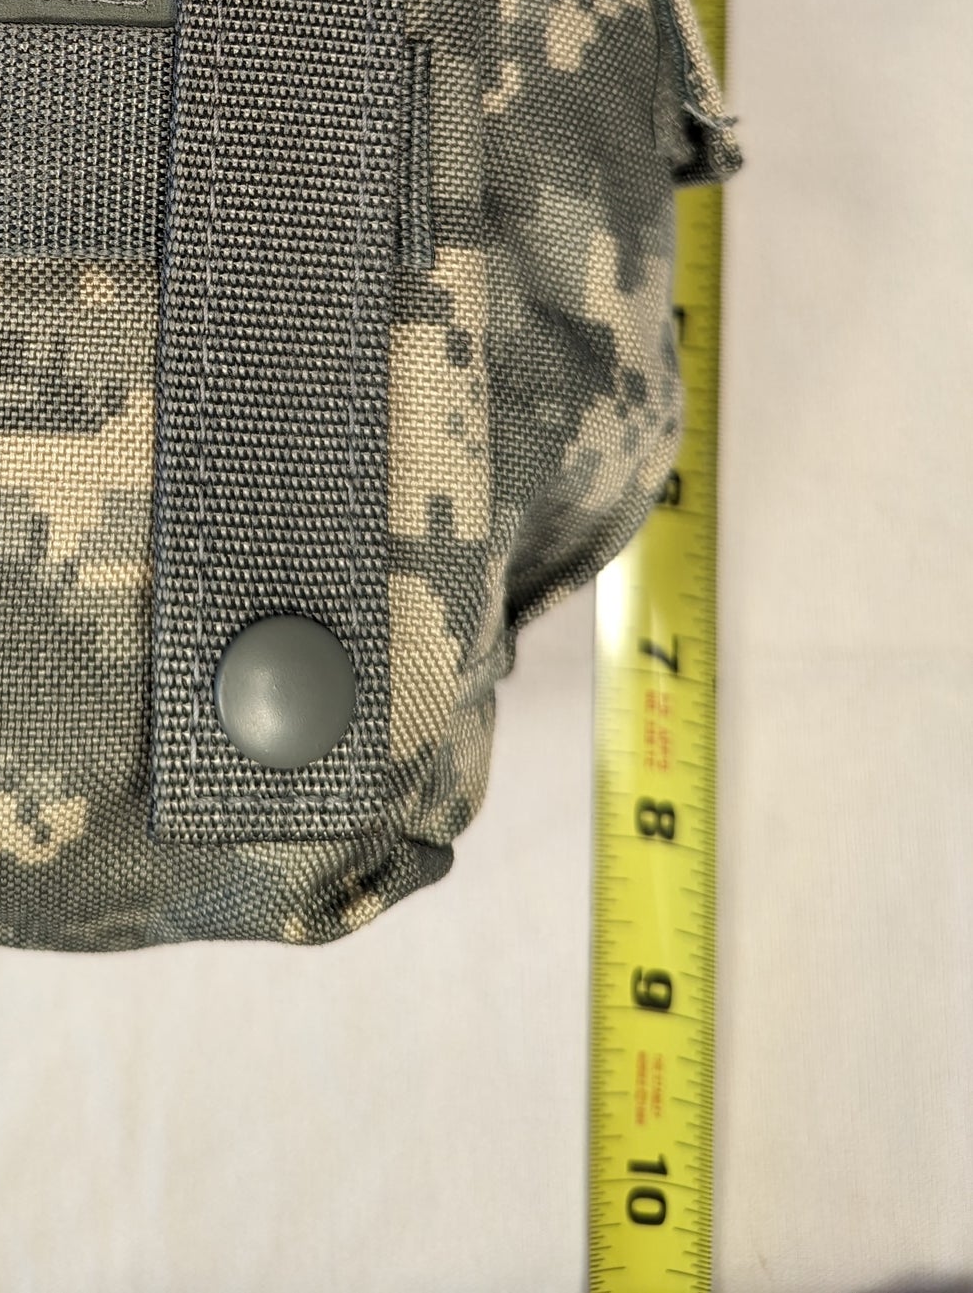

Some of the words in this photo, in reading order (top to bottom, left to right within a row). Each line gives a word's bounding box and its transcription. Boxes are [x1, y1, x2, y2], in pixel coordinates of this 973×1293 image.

[636, 633, 681, 673] 7
[634, 795, 677, 841] 8
[629, 965, 673, 1013] 9
[626, 1152, 669, 1227] 10
